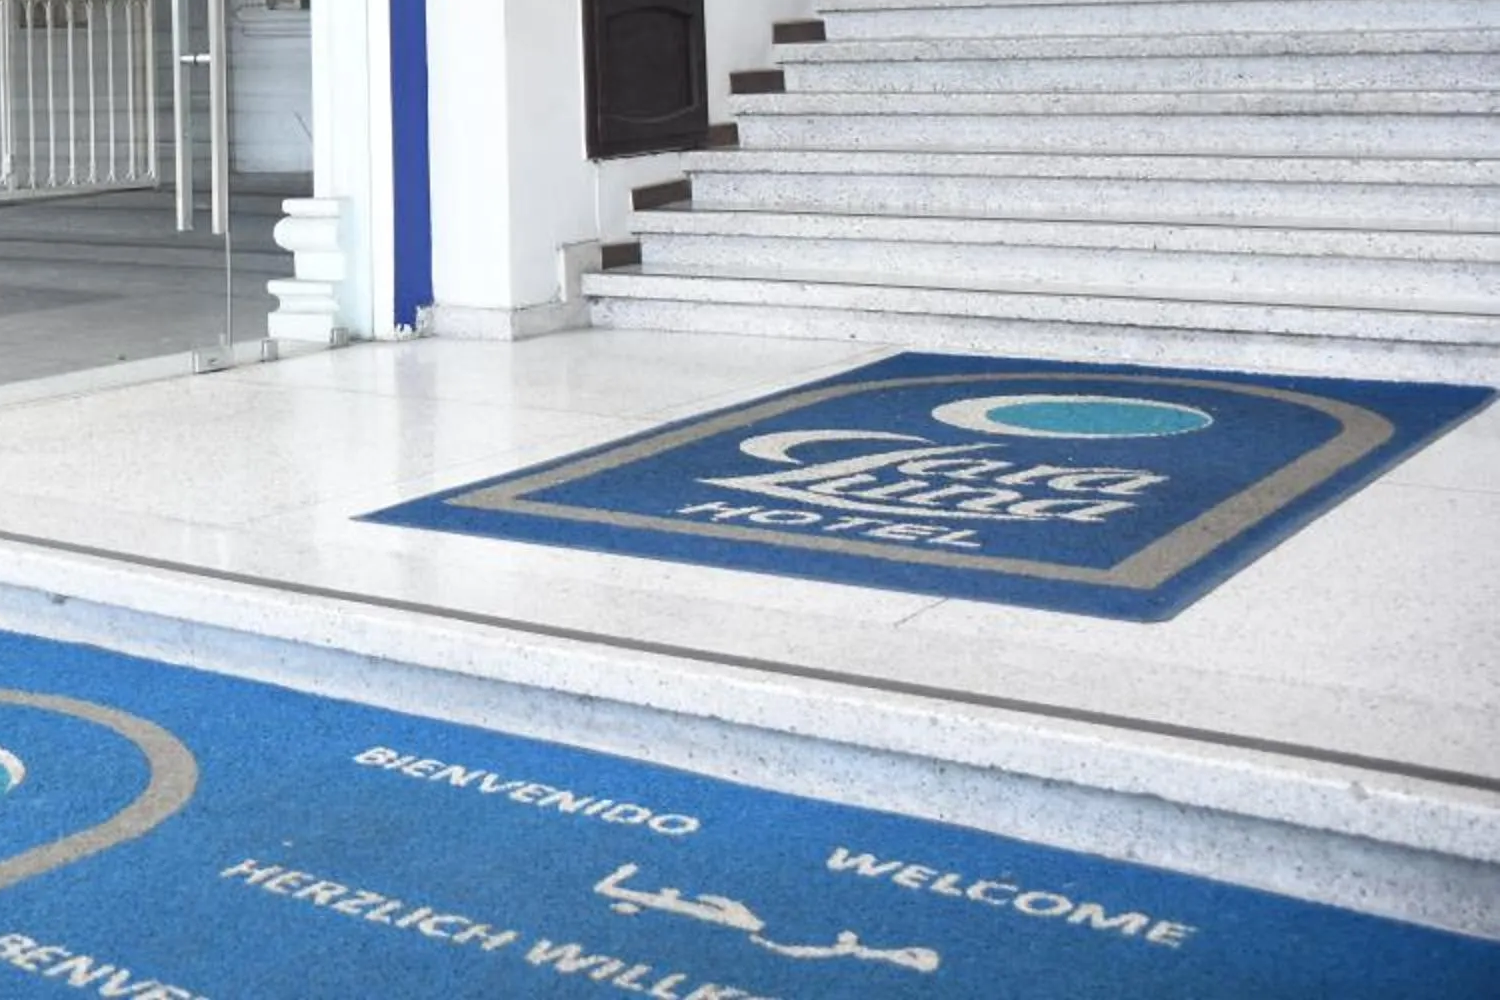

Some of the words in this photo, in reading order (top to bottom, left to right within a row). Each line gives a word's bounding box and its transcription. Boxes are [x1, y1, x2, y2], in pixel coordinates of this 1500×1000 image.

[677, 500, 982, 549] HOTEL
[696, 458, 1137, 522] Luna
[351, 746, 702, 835] BIENVENIDO
[220, 858, 519, 952] HERZLICH
[593, 862, 941, 974] مرحبا
[825, 847, 1201, 949] WELCOME
